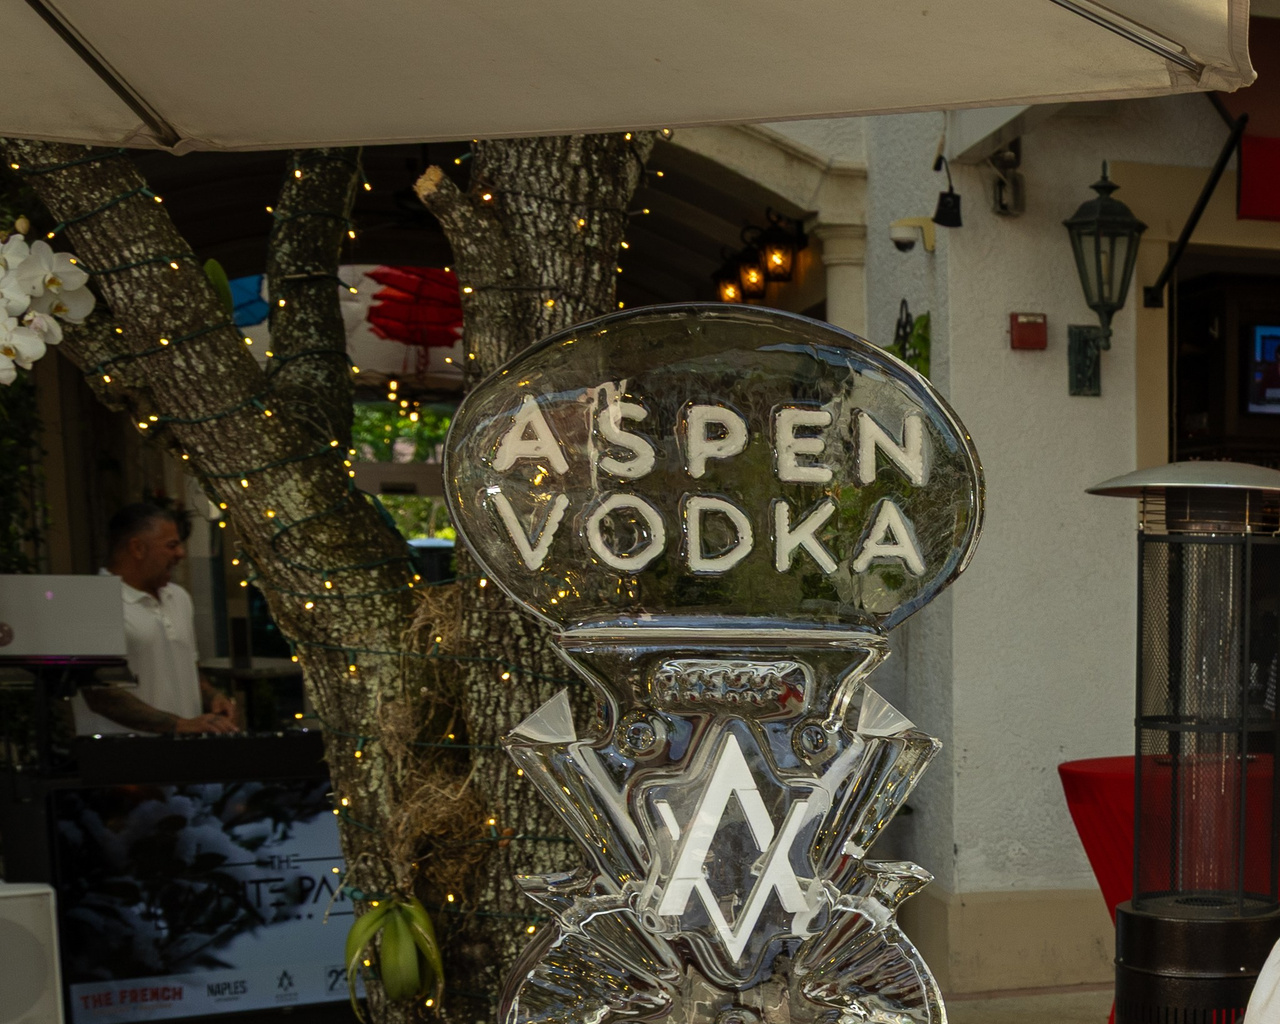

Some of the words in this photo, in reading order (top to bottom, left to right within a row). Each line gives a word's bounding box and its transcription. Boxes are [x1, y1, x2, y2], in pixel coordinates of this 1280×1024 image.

[493, 395, 925, 486] ASPEN
[493, 493, 926, 575] VODKA
[269, 853, 300, 871] THE
[80, 992, 113, 1009] THE
[119, 987, 184, 1003] FRENCH
[207, 980, 248, 997] NAPLES
